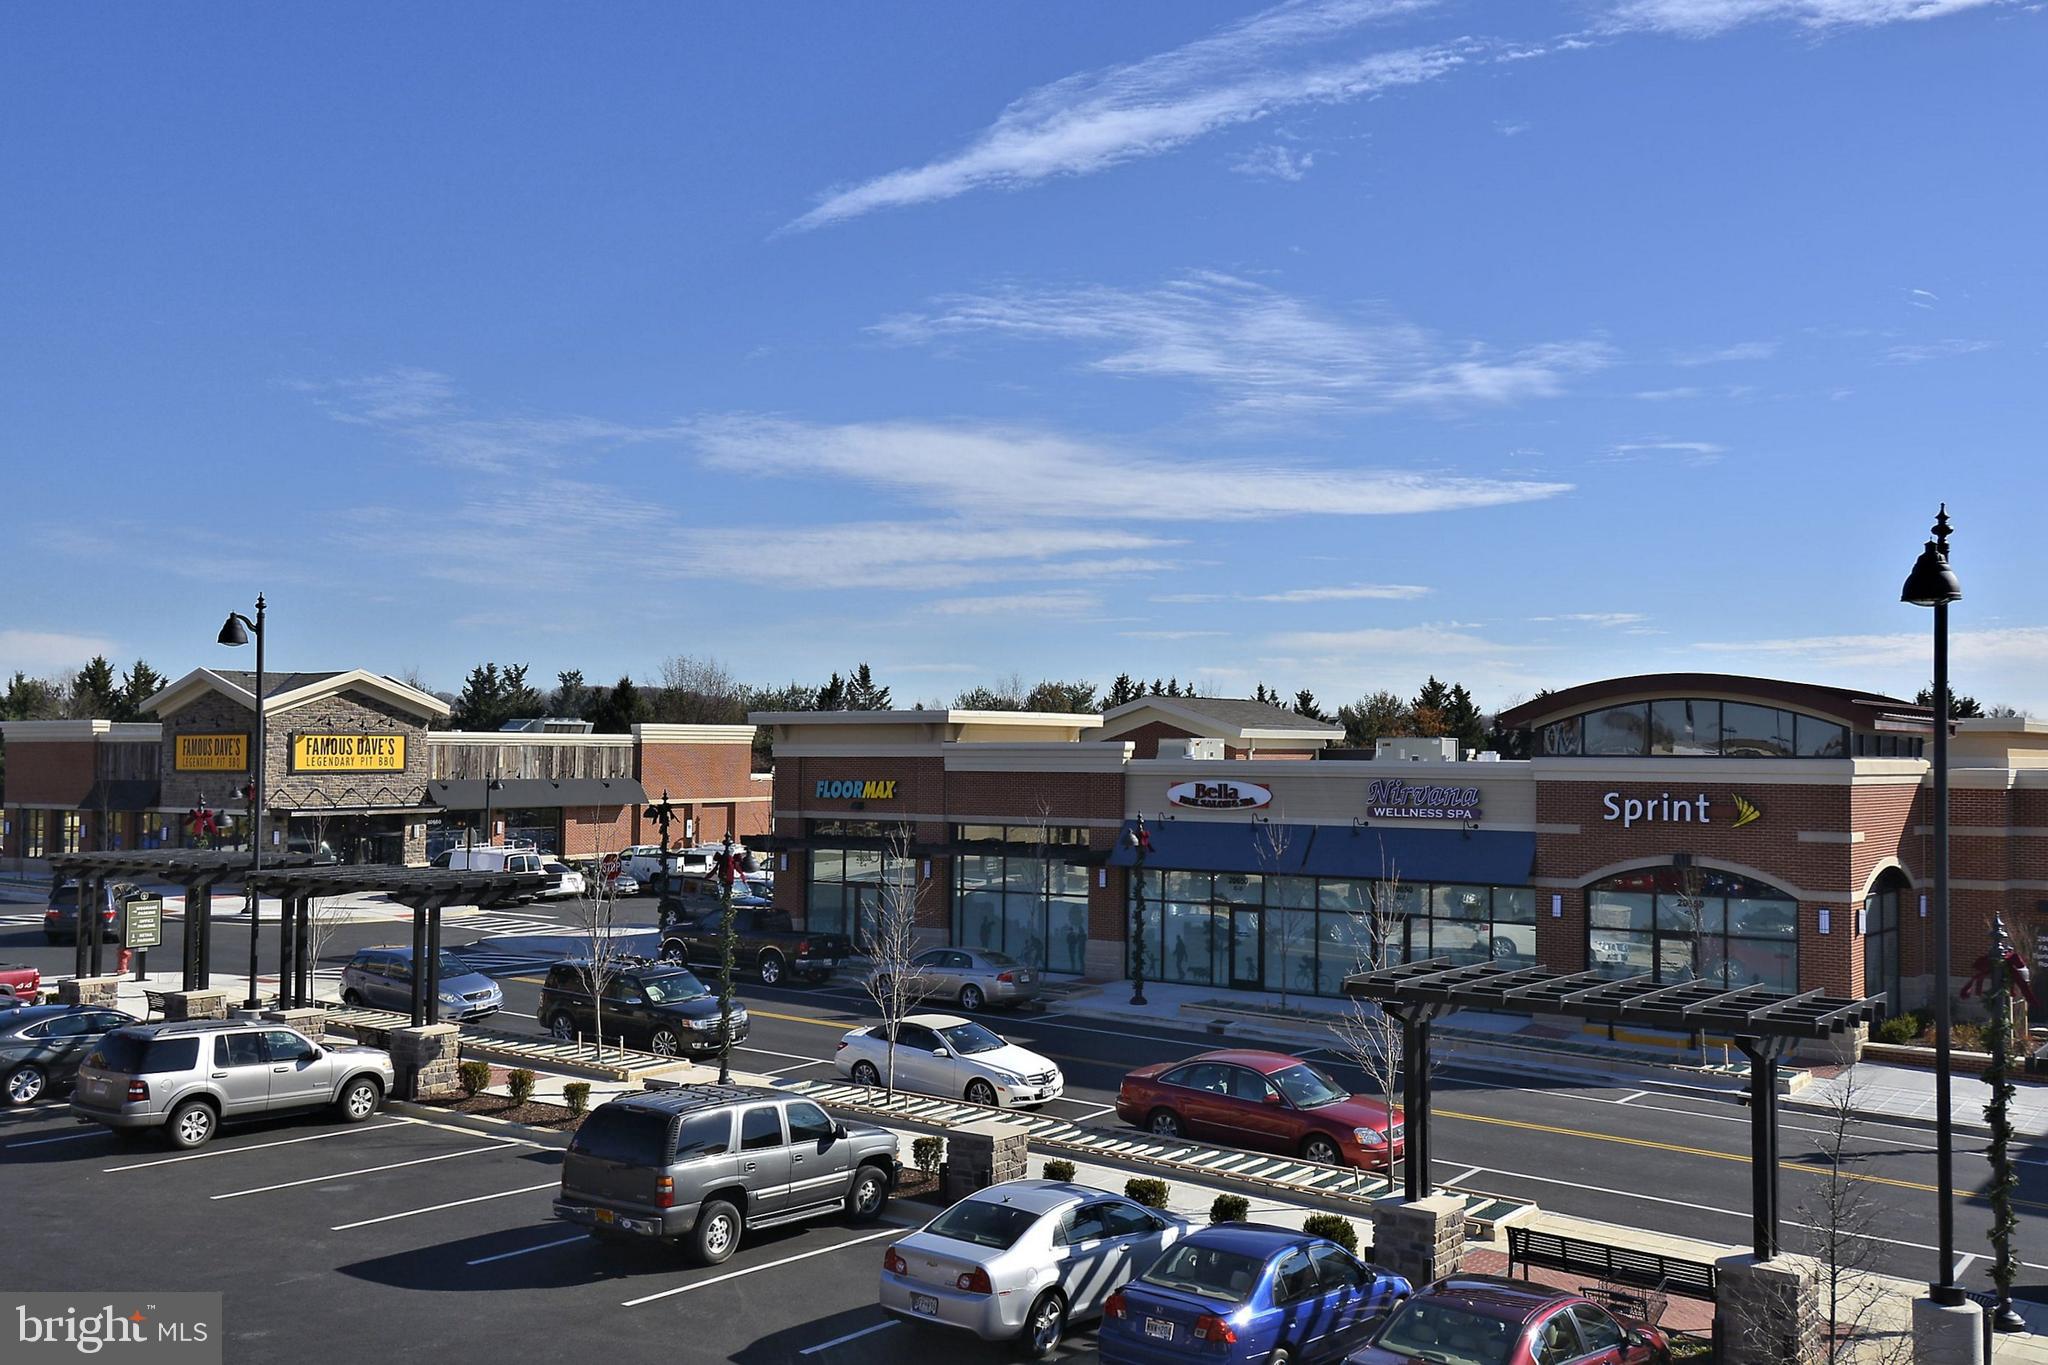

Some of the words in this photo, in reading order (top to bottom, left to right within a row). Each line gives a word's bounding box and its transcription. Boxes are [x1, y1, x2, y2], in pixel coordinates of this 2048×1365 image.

[183, 738, 212, 756] FAMOUS
[214, 738, 240, 756] DAVE'S
[306, 737, 353, 755] FAMOUS
[357, 737, 395, 755] DAVE'S
[183, 757, 213, 767] LEGENDARY
[306, 757, 354, 767] LEGENDARY
[361, 757, 373, 766] PIT
[378, 757, 394, 767] BBQ
[816, 780, 895, 799] FLOORMAX
[1195, 783, 1239, 799] Bella
[1366, 779, 1479, 807] Nirvana
[1374, 807, 1443, 818] WELLNESS
[1447, 808, 1472, 819] SPA
[1603, 792, 1710, 828] Sprint
[603, 861, 621, 873] STOP
